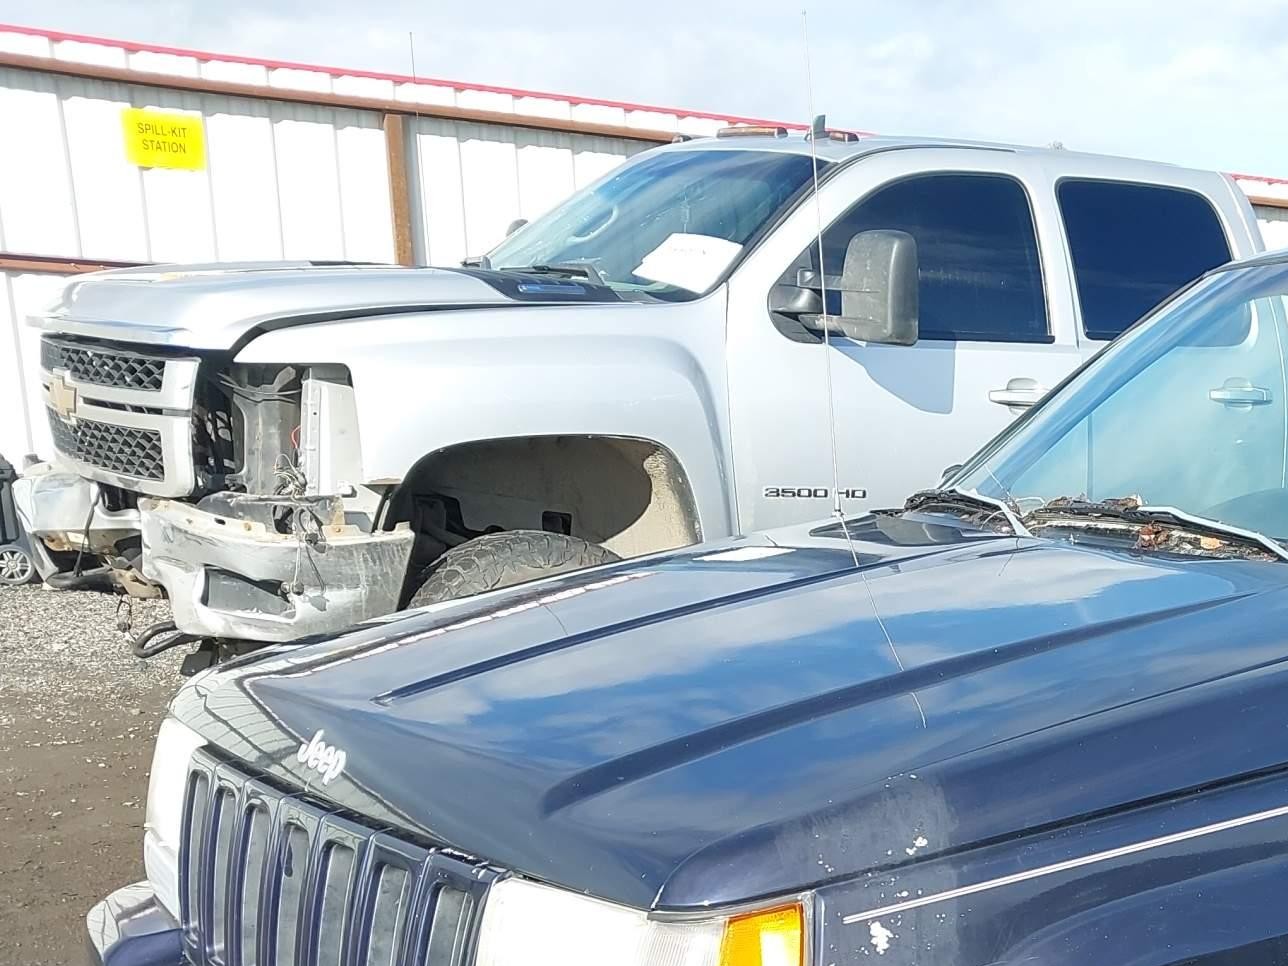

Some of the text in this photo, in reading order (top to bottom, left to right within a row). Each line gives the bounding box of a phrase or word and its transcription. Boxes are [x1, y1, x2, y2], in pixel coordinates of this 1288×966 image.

[137, 122, 187, 138] SPILL-KIT
[142, 139, 187, 154] STATION
[764, 487, 828, 498] 3500
[297, 728, 346, 786] Jeep
